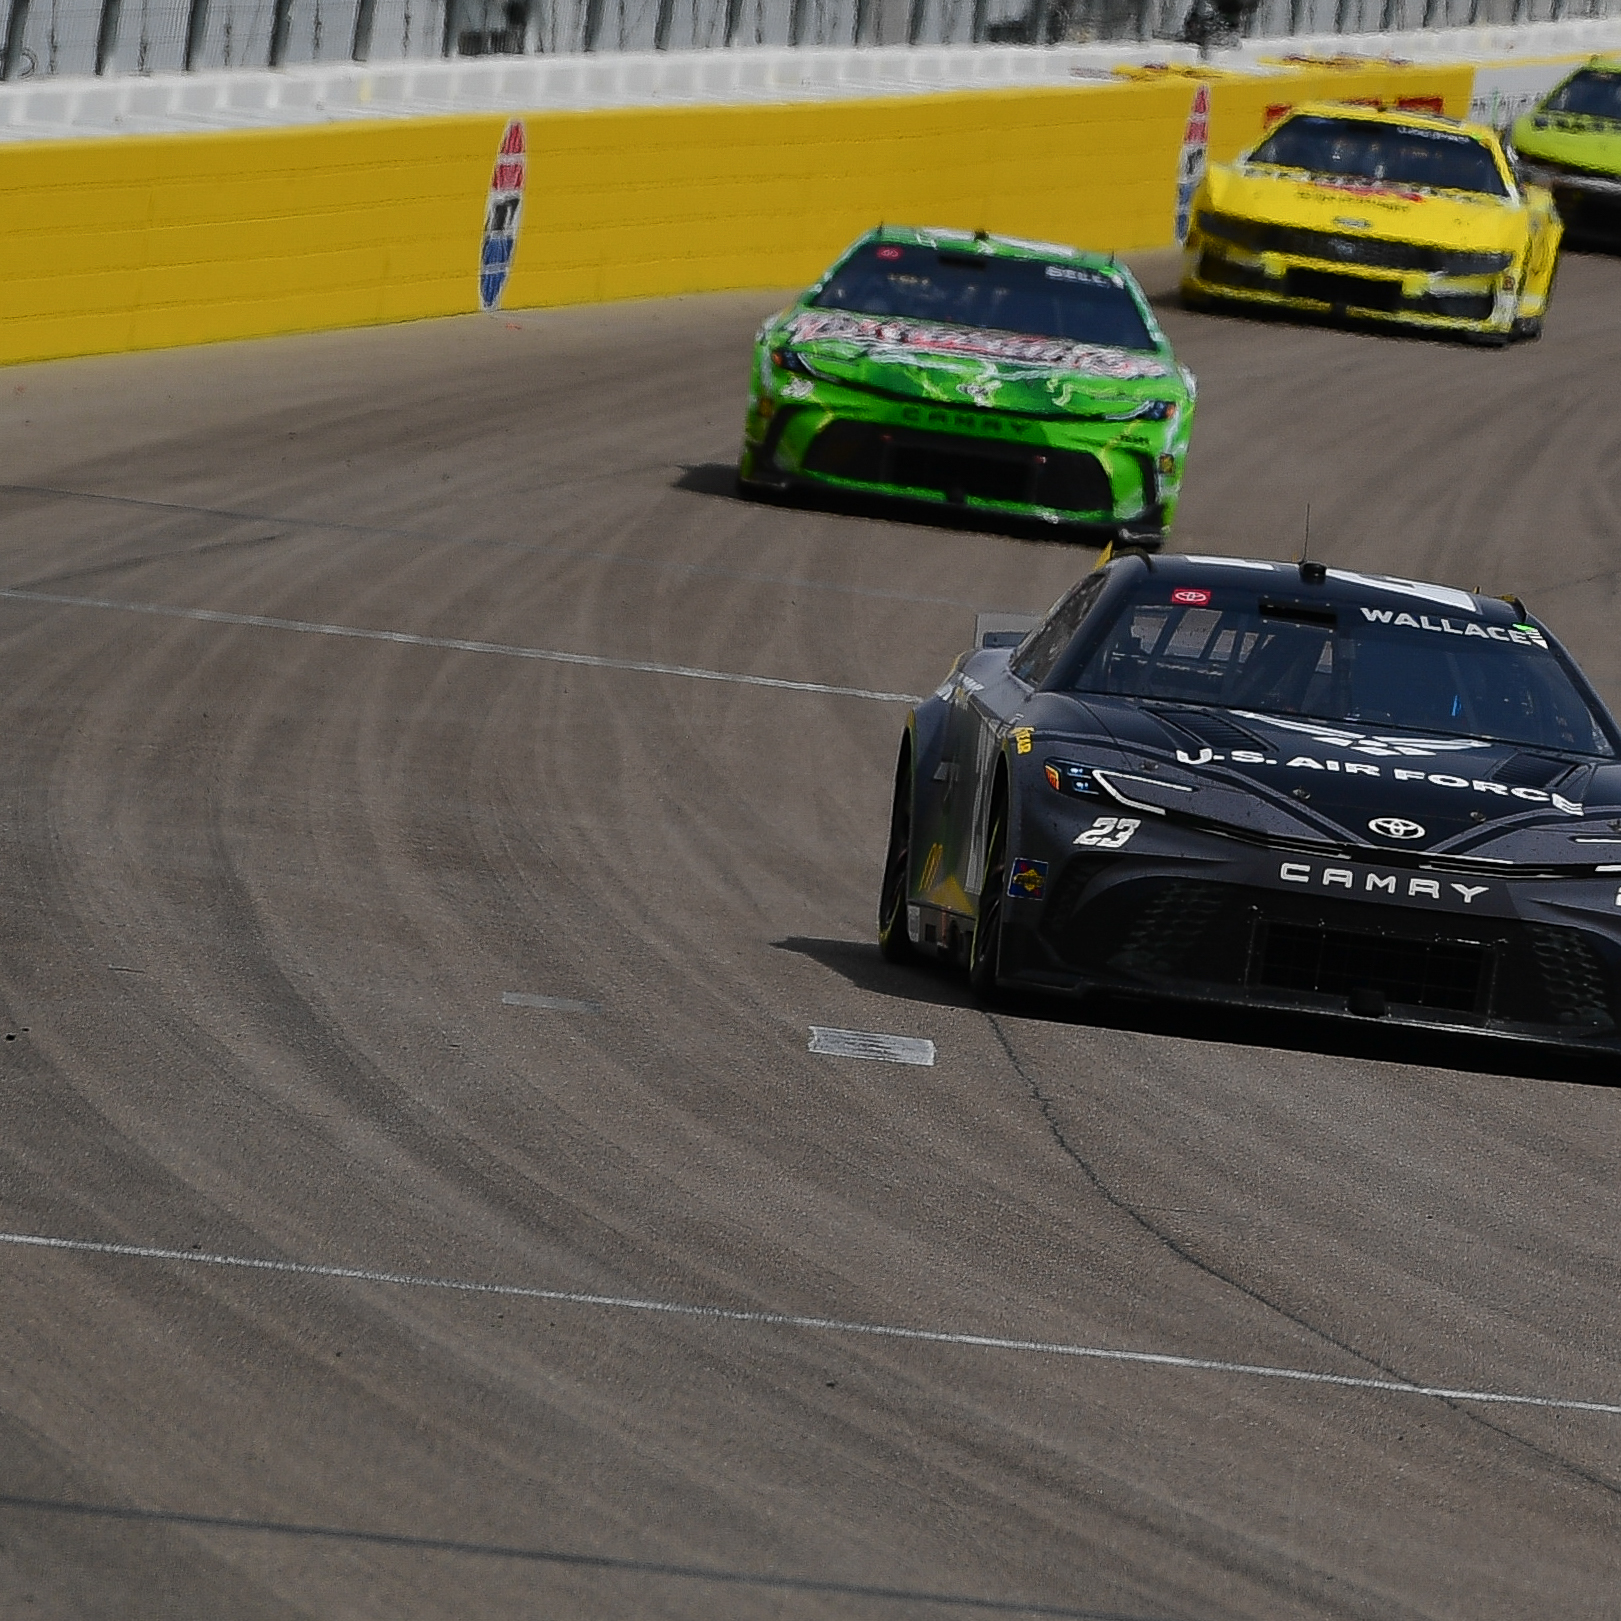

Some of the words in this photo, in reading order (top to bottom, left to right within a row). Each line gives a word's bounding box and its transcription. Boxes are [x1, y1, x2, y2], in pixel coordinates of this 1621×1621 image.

[1359, 606, 1533, 646] WALLACE
[1176, 747, 1278, 766] U.S.
[1286, 755, 1381, 777] AIR
[1393, 766, 1584, 817] FORCE
[1072, 816, 1142, 849] 23
[1279, 860, 1490, 904] CAMRY
